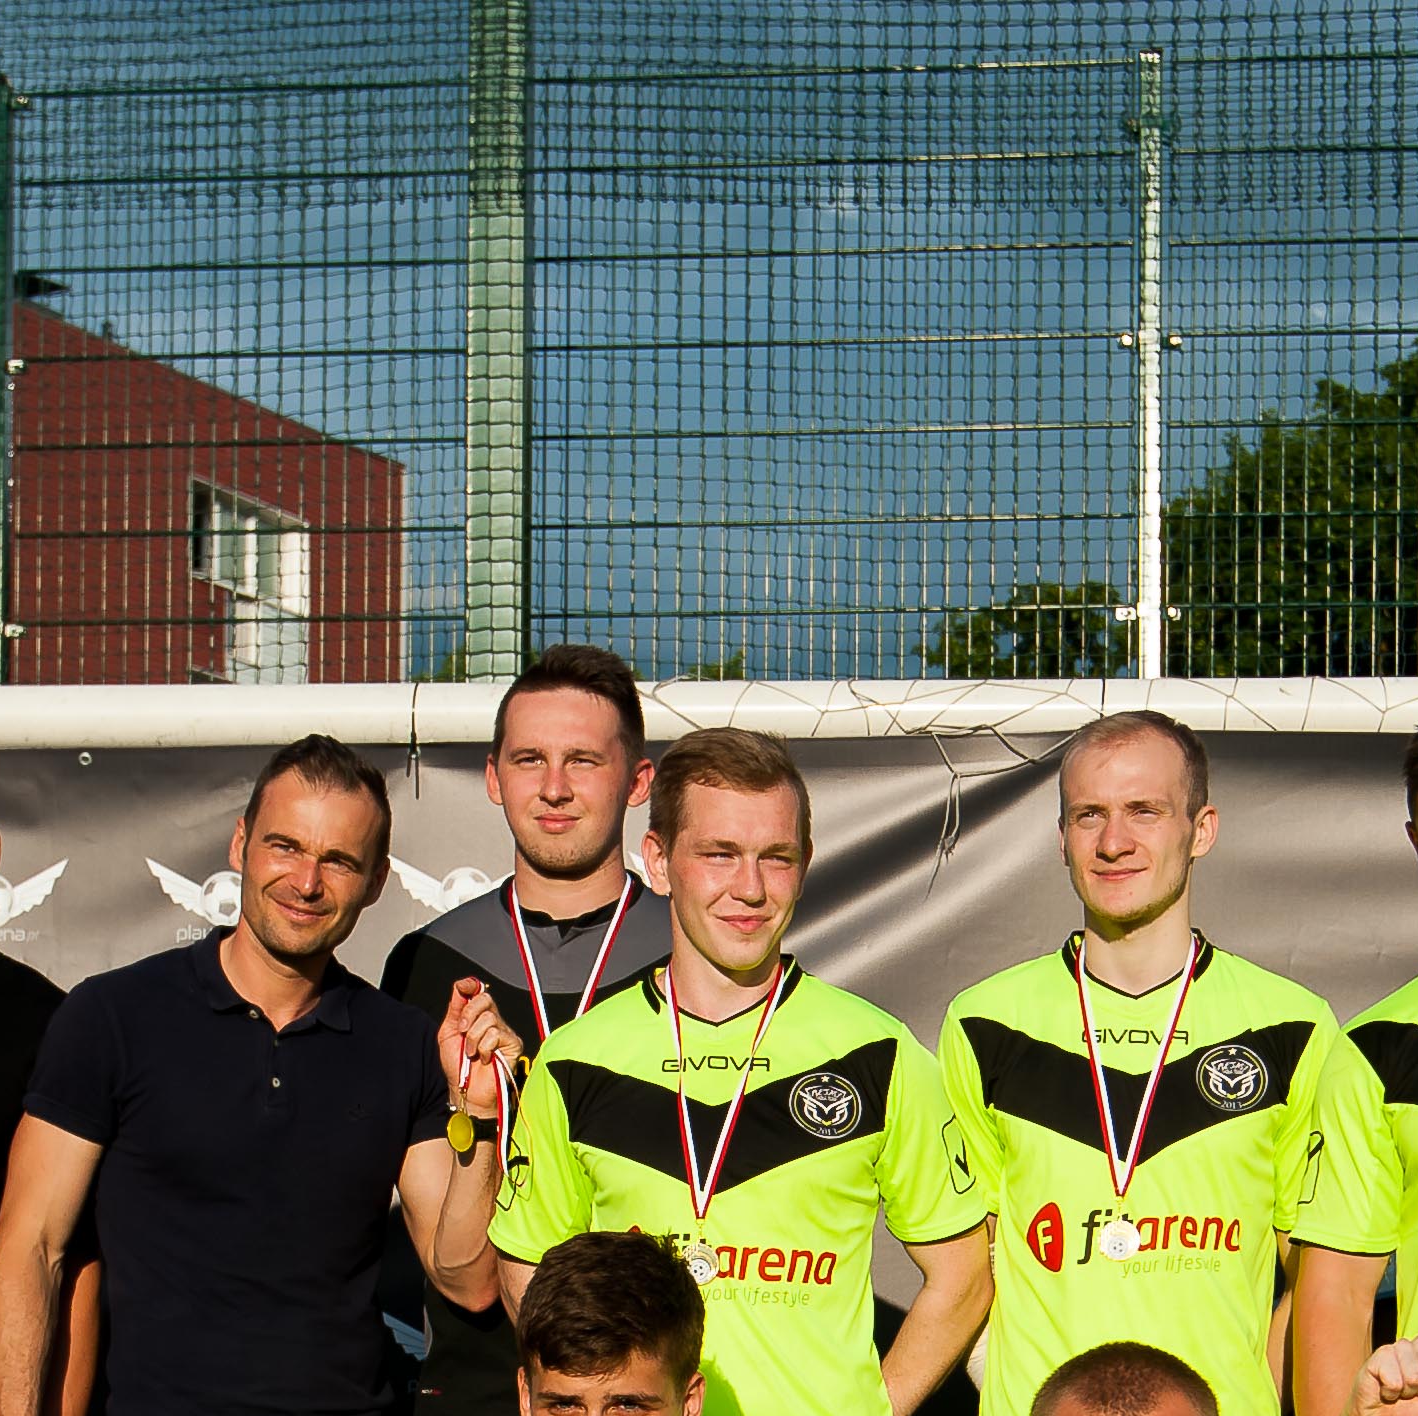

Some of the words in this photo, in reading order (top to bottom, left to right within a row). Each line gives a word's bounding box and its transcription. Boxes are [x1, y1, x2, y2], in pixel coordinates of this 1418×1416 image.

[1081, 1028, 1189, 1045] GIVOVA
[662, 1056, 770, 1073] GIVOVA
[1077, 1209, 1240, 1265] farena
[669, 1233, 837, 1285] arena
[1121, 1260, 1159, 1279] your
